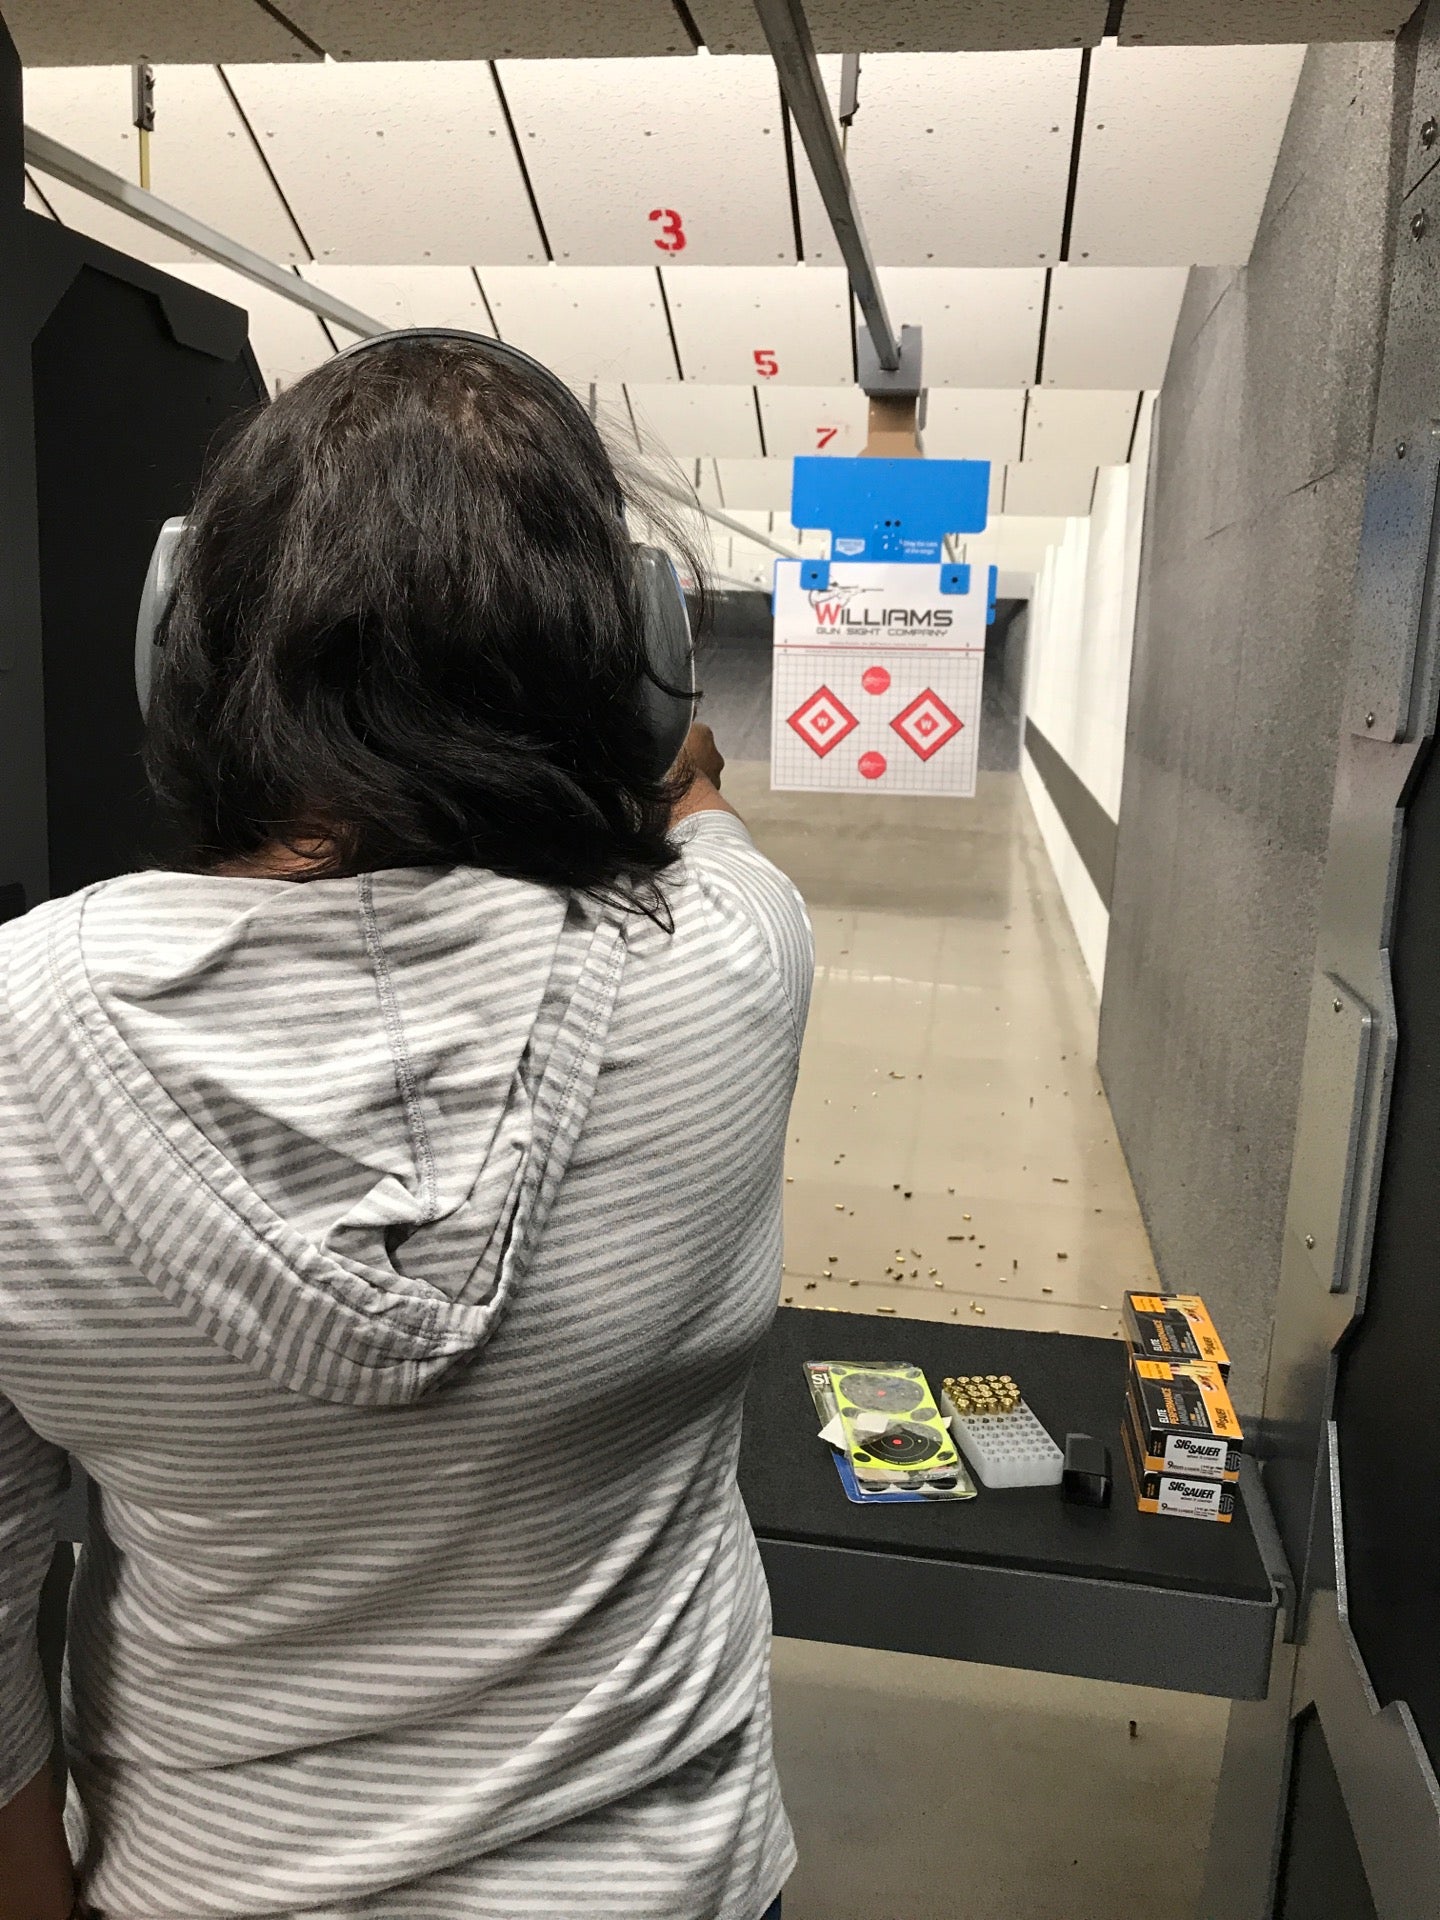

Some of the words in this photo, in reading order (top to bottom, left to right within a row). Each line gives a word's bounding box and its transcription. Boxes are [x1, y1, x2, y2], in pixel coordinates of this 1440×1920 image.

[648, 209, 687, 252] 3
[753, 350, 779, 376] 5
[816, 428, 838, 449] 7
[815, 603, 953, 627] WILLIAMS
[816, 627, 840, 635] GUN
[847, 627, 881, 636] SIGHT
[888, 628, 948, 637] COMPANY
[1150, 1338, 1163, 1352] ELITE
[1161, 1387, 1180, 1425] PERFORMANCE
[1156, 1408, 1170, 1424] ELITE
[1188, 1445, 1221, 1457] SAUER
[1182, 1488, 1215, 1500] SAUER
